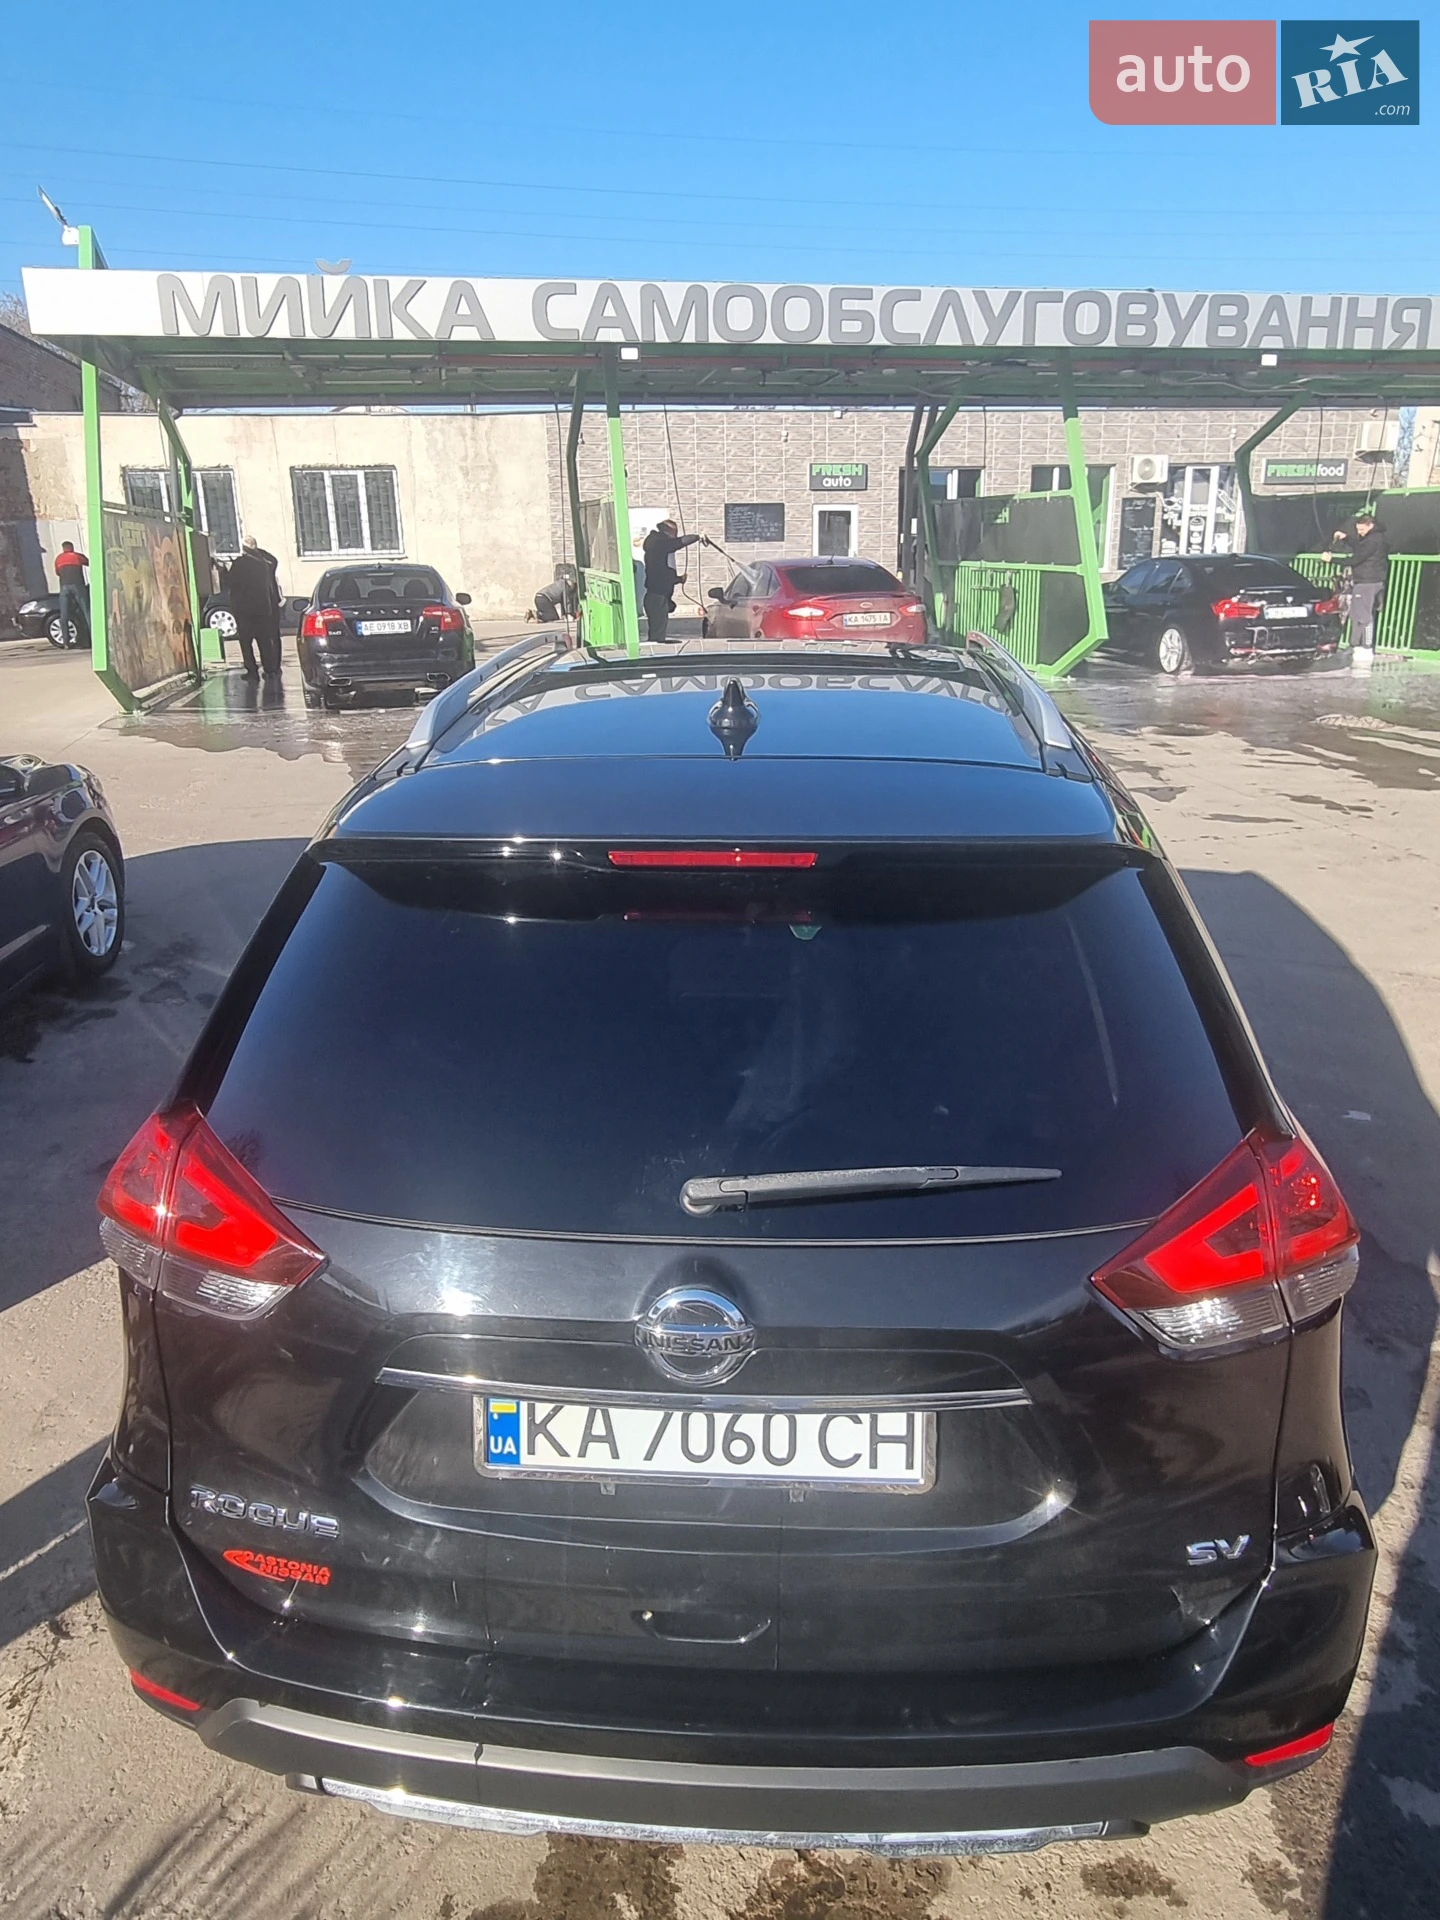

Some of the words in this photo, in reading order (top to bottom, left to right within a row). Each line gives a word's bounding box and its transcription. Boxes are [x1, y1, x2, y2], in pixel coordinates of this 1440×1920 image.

[157, 259, 496, 340] МИЙКА
[532, 282, 1432, 349] САМООБСЛУГОВУВАННЯ
[812, 464, 862, 476] FRESH
[822, 476, 852, 487] auto
[648, 1333, 741, 1351] NISSAN
[490, 1436, 517, 1455] UA
[527, 1402, 620, 1460] KA
[643, 1411, 797, 1467] 7060
[818, 1412, 915, 1470] CH
[190, 1484, 341, 1539] ROGUE
[1186, 1534, 1251, 1566] SV
[260, 1563, 329, 1586] NISSAN
